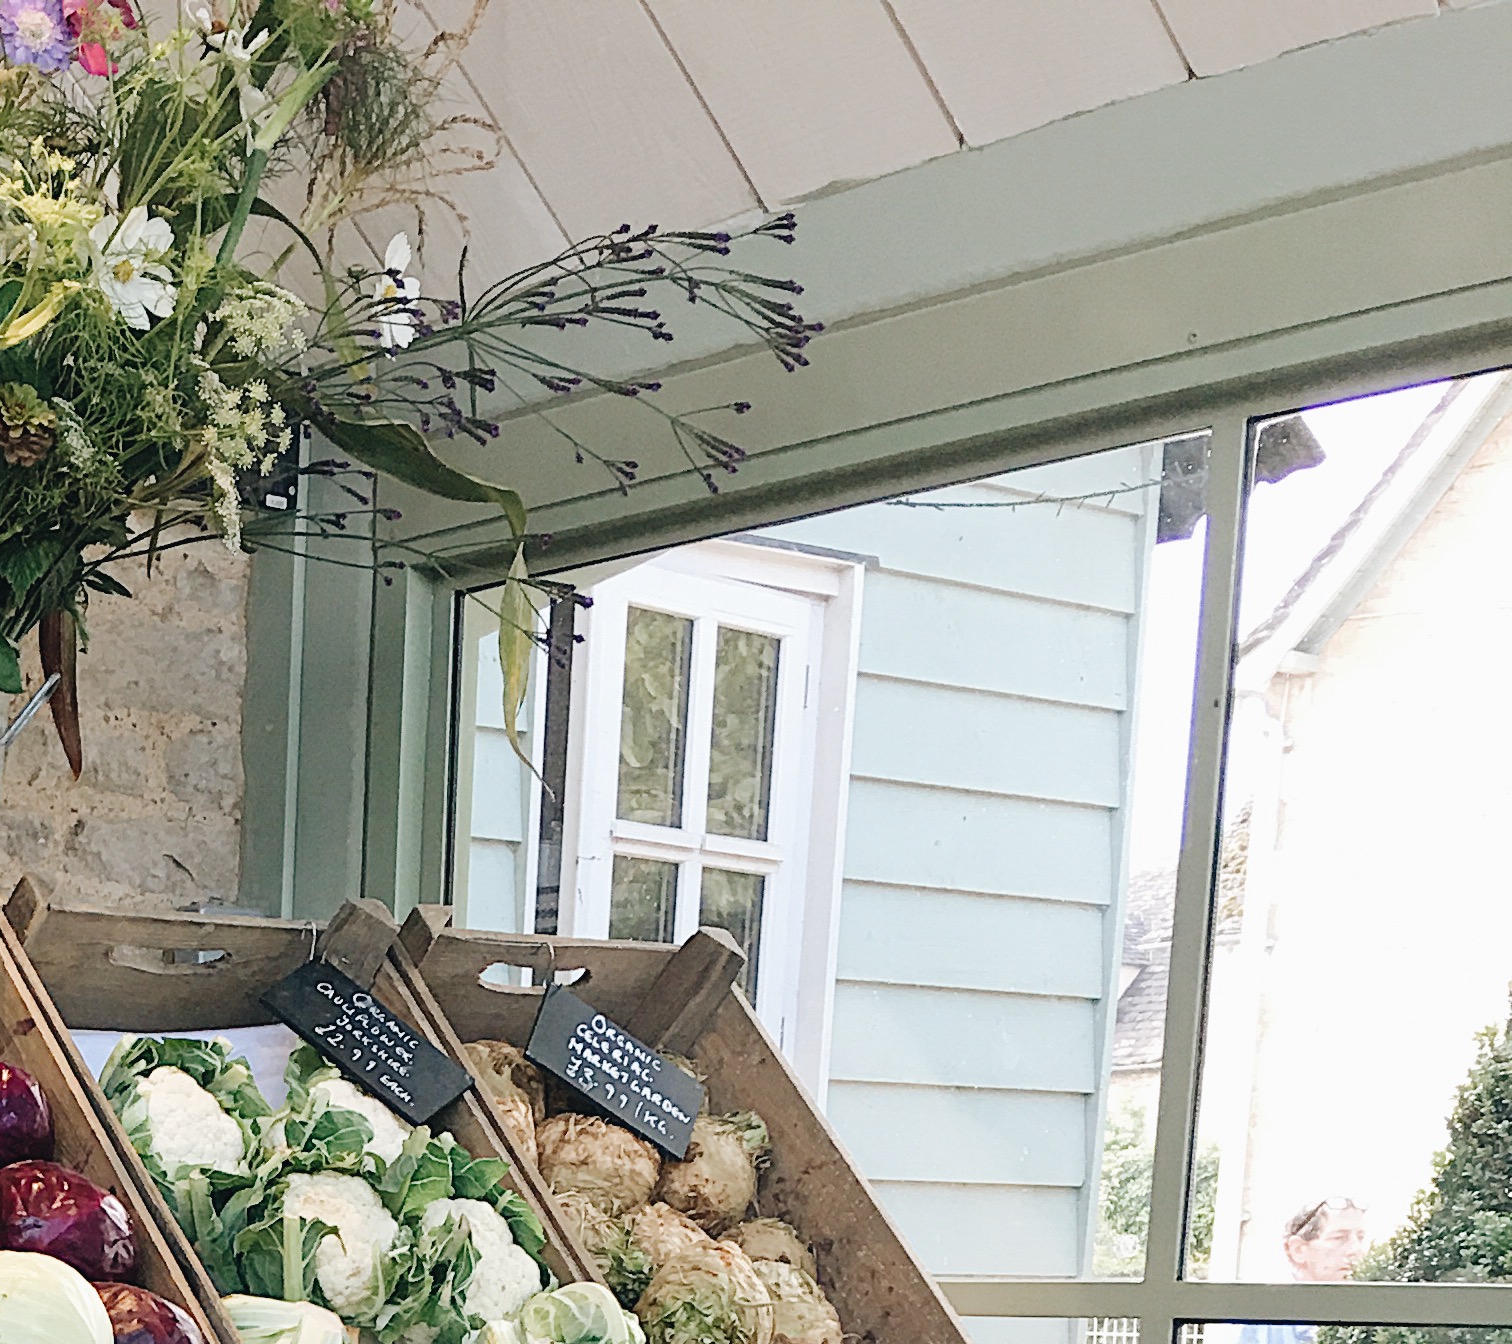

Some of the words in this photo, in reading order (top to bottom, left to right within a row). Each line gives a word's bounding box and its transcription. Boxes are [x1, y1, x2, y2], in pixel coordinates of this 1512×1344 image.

[353, 992, 419, 1049] ORGANIC
[591, 1014, 661, 1071] ORGANIC
[568, 1037, 629, 1083] MARKET
[630, 1080, 691, 1124] GARDEN
